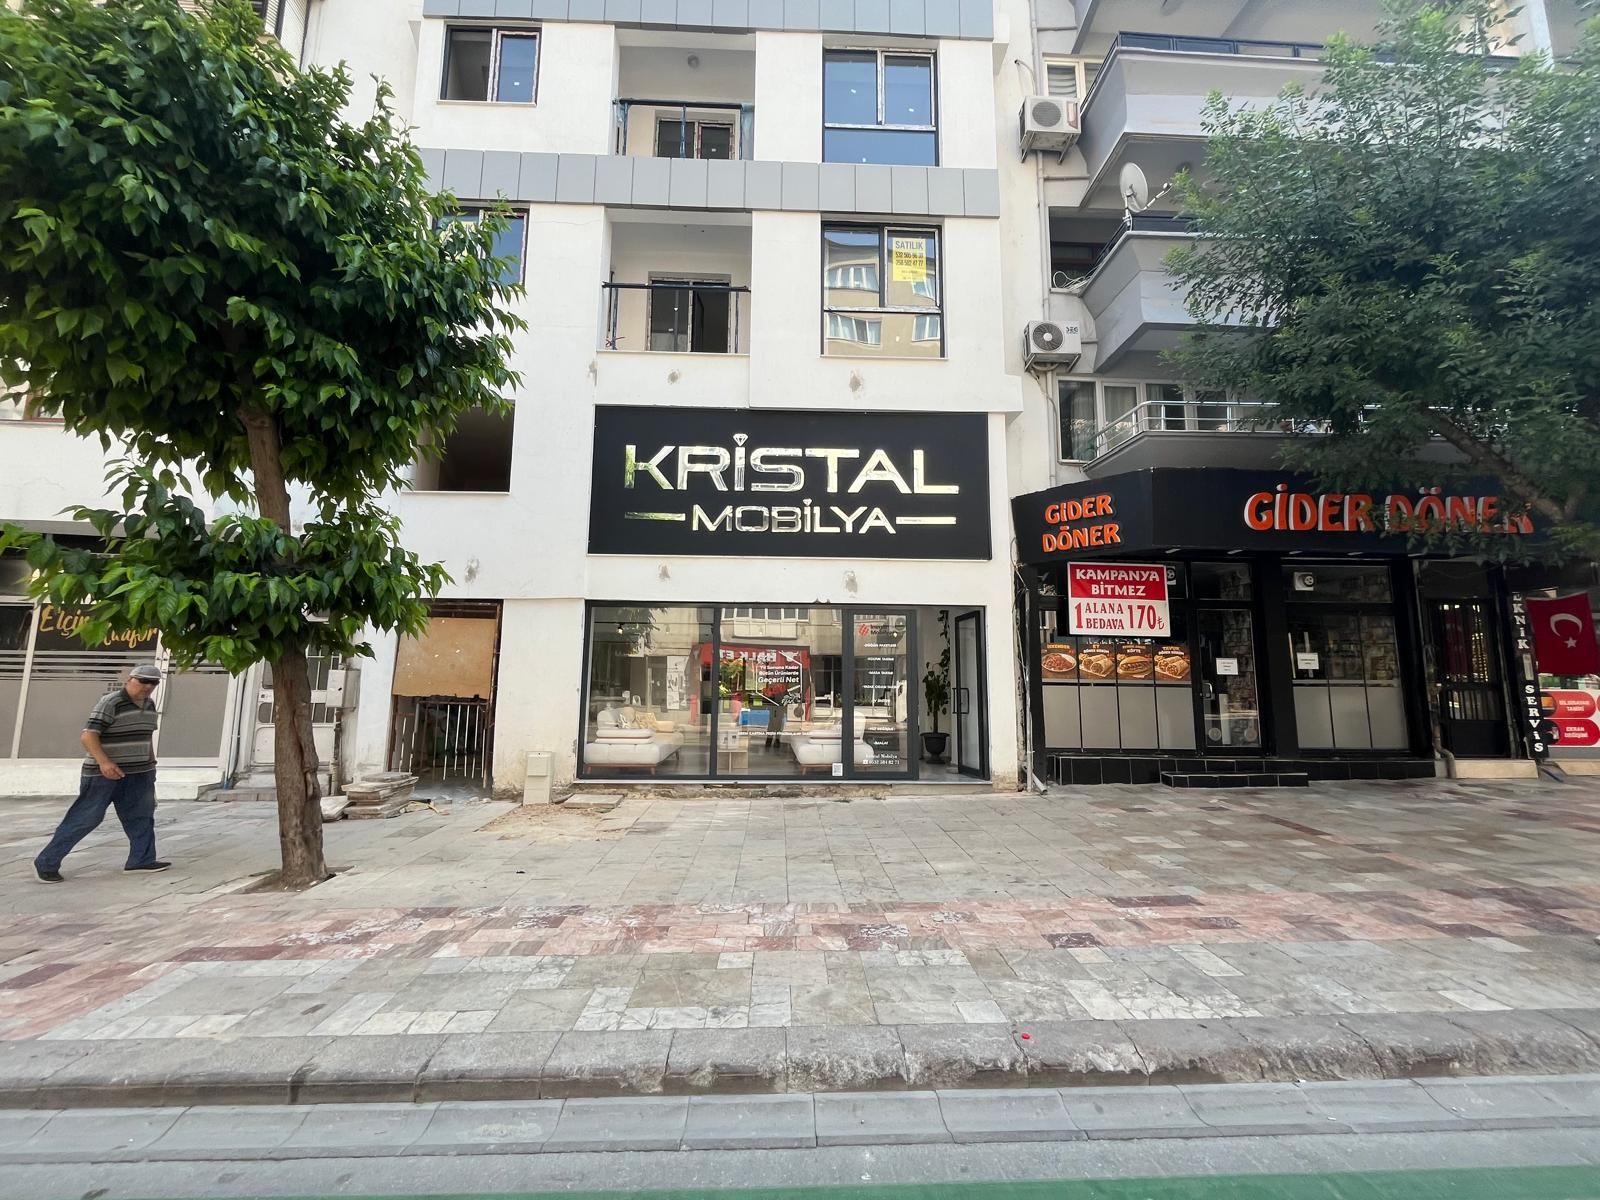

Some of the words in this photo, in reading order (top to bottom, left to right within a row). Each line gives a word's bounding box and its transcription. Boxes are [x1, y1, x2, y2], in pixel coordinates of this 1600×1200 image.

[895, 240, 924, 250] SATILIK
[624, 433, 960, 494] KRİSTAL
[692, 498, 896, 534] MOBİLYA
[1044, 494, 1114, 524] GİDER
[1244, 483, 1375, 532] GİDER
[1042, 523, 1122, 553] DÖNER
[1075, 568, 1160, 582] KAMPANYA
[1091, 581, 1147, 596] BİTMEZ
[1074, 602, 1084, 629] 1
[1085, 602, 1124, 614] ALANA
[1086, 617, 1125, 630] BEDAVA
[1512, 591, 1530, 649] EKNİK
[758, 676, 784, 684] Geçerli
[1525, 684, 1544, 752] SERVİS
